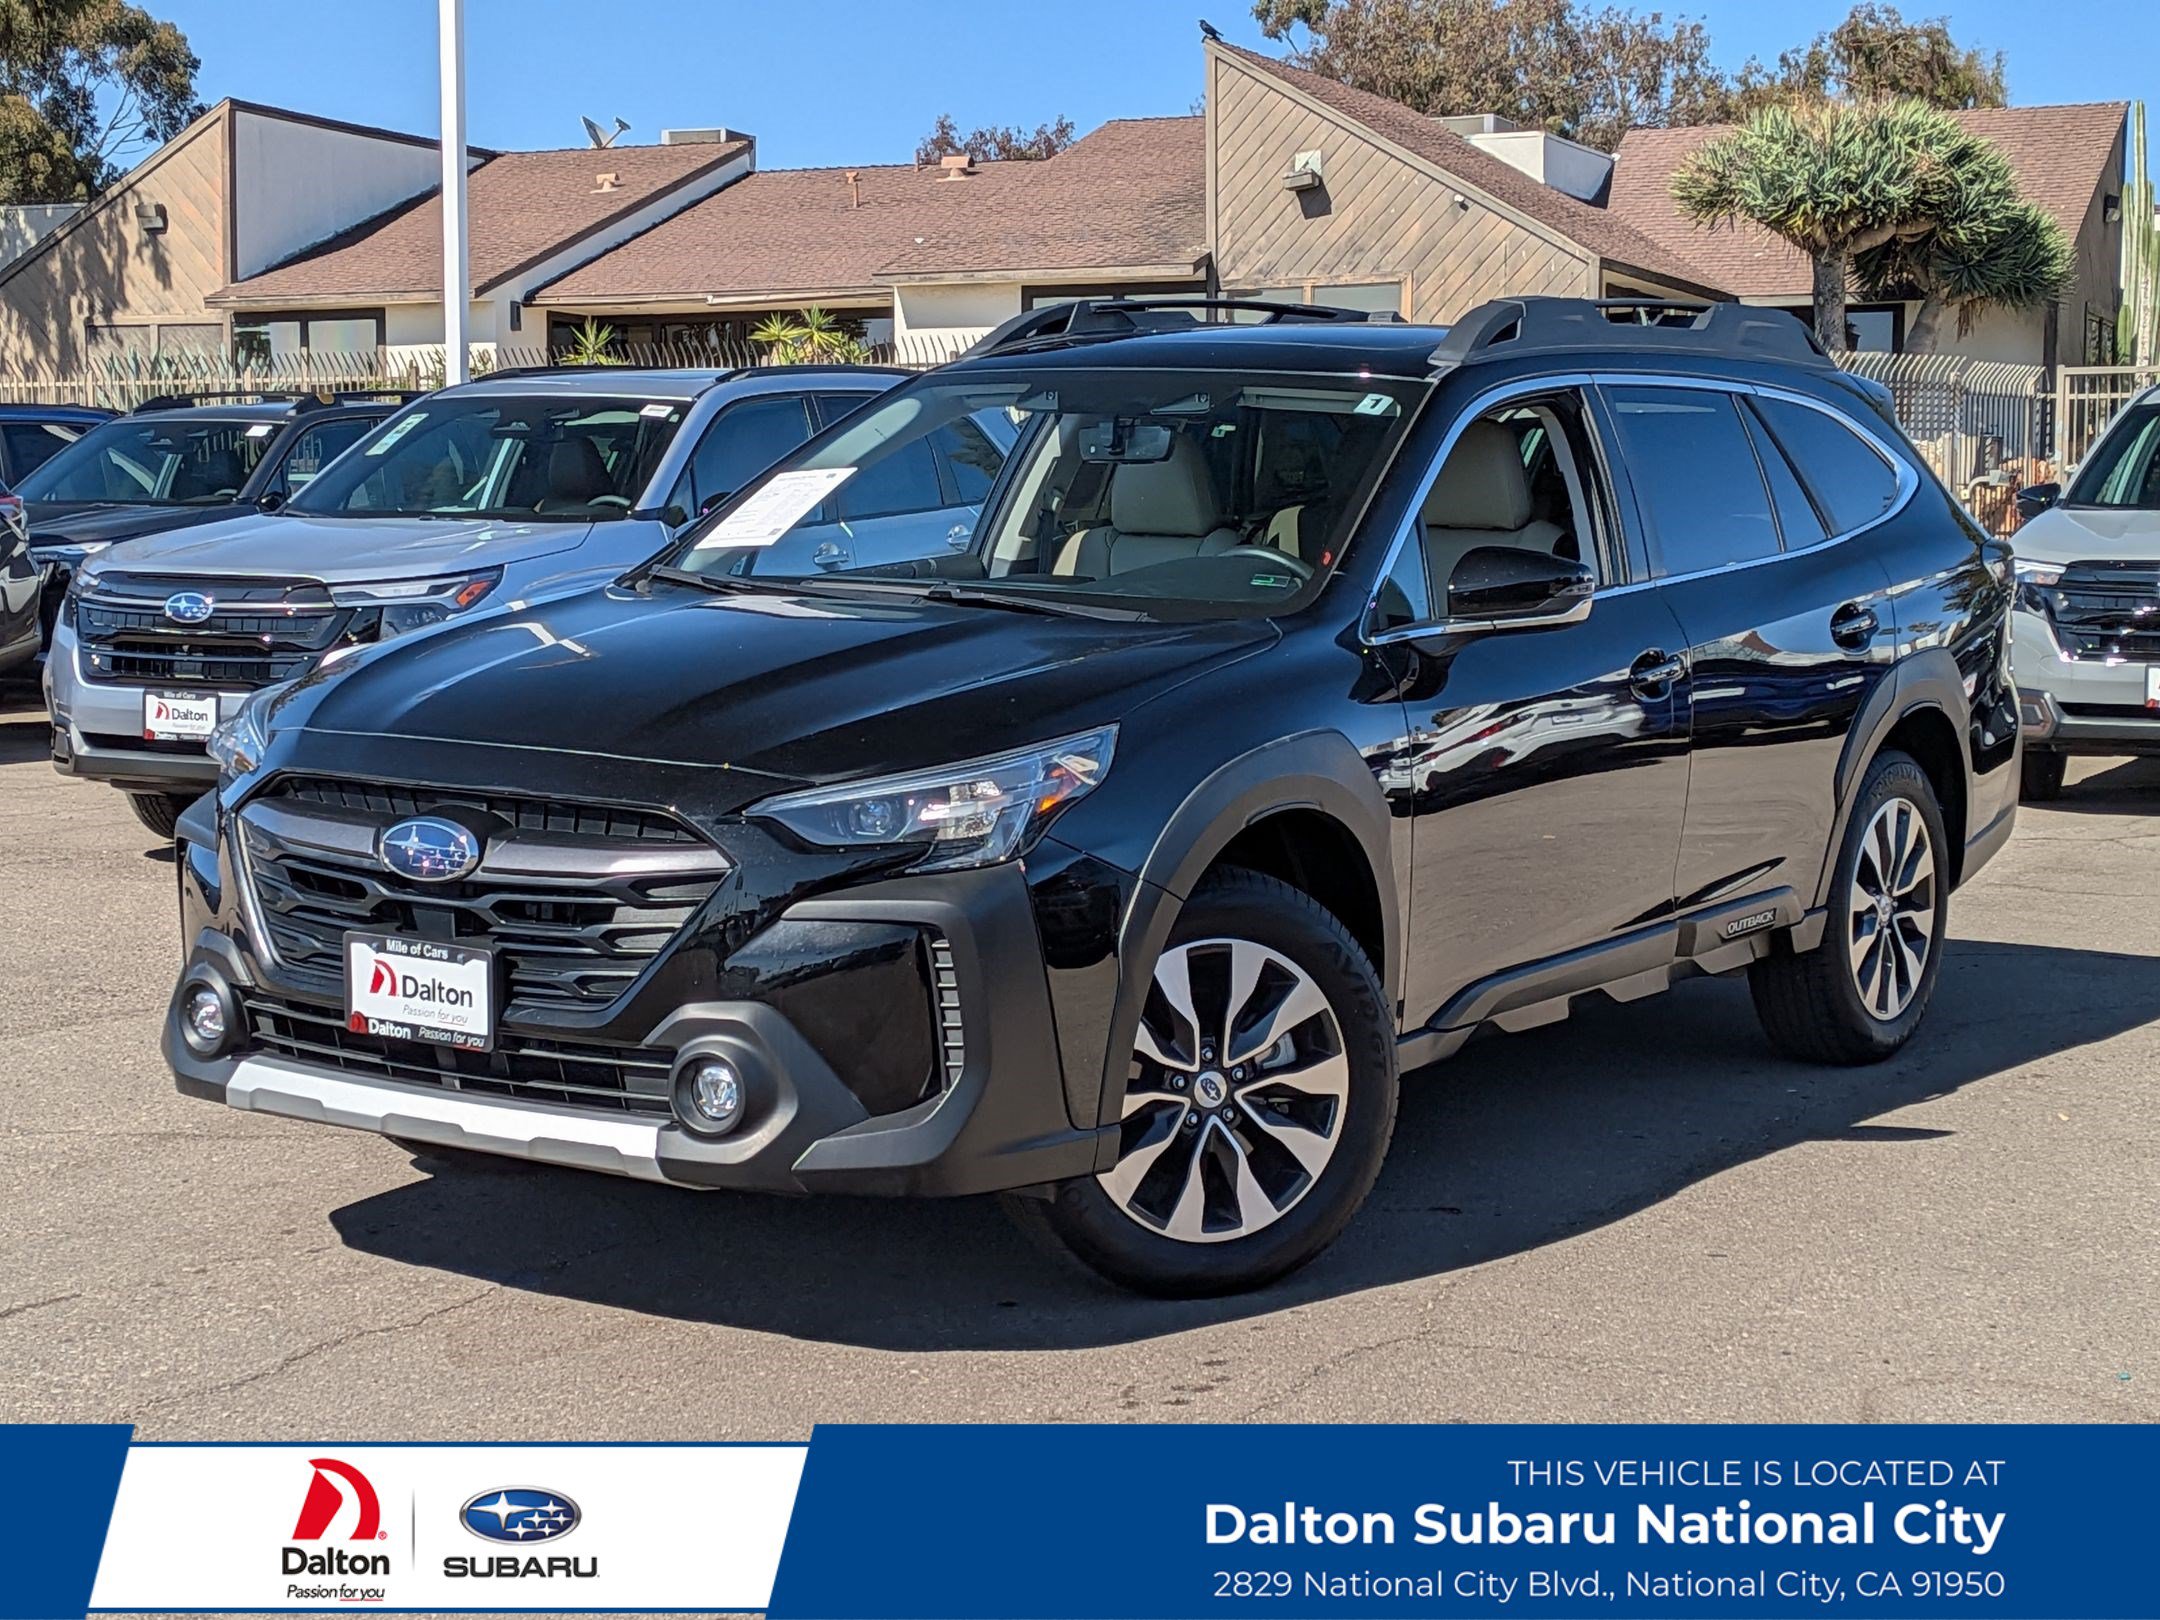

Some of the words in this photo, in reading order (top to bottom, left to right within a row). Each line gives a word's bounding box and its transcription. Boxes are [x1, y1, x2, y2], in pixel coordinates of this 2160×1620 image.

[171, 708, 208, 721] Dalton
[1727, 910, 1774, 934] OUTBACK
[386, 939, 408, 954] Mile
[409, 942, 421, 956] of
[422, 945, 448, 960] Cars
[402, 974, 473, 1008] Dalton
[402, 1004, 436, 1020] Passion
[437, 1008, 450, 1022] for
[451, 1013, 469, 1025] you
[368, 1018, 412, 1040] Dalton
[418, 1026, 452, 1043] Passion
[452, 1031, 467, 1046] for
[467, 1036, 485, 1048] you
